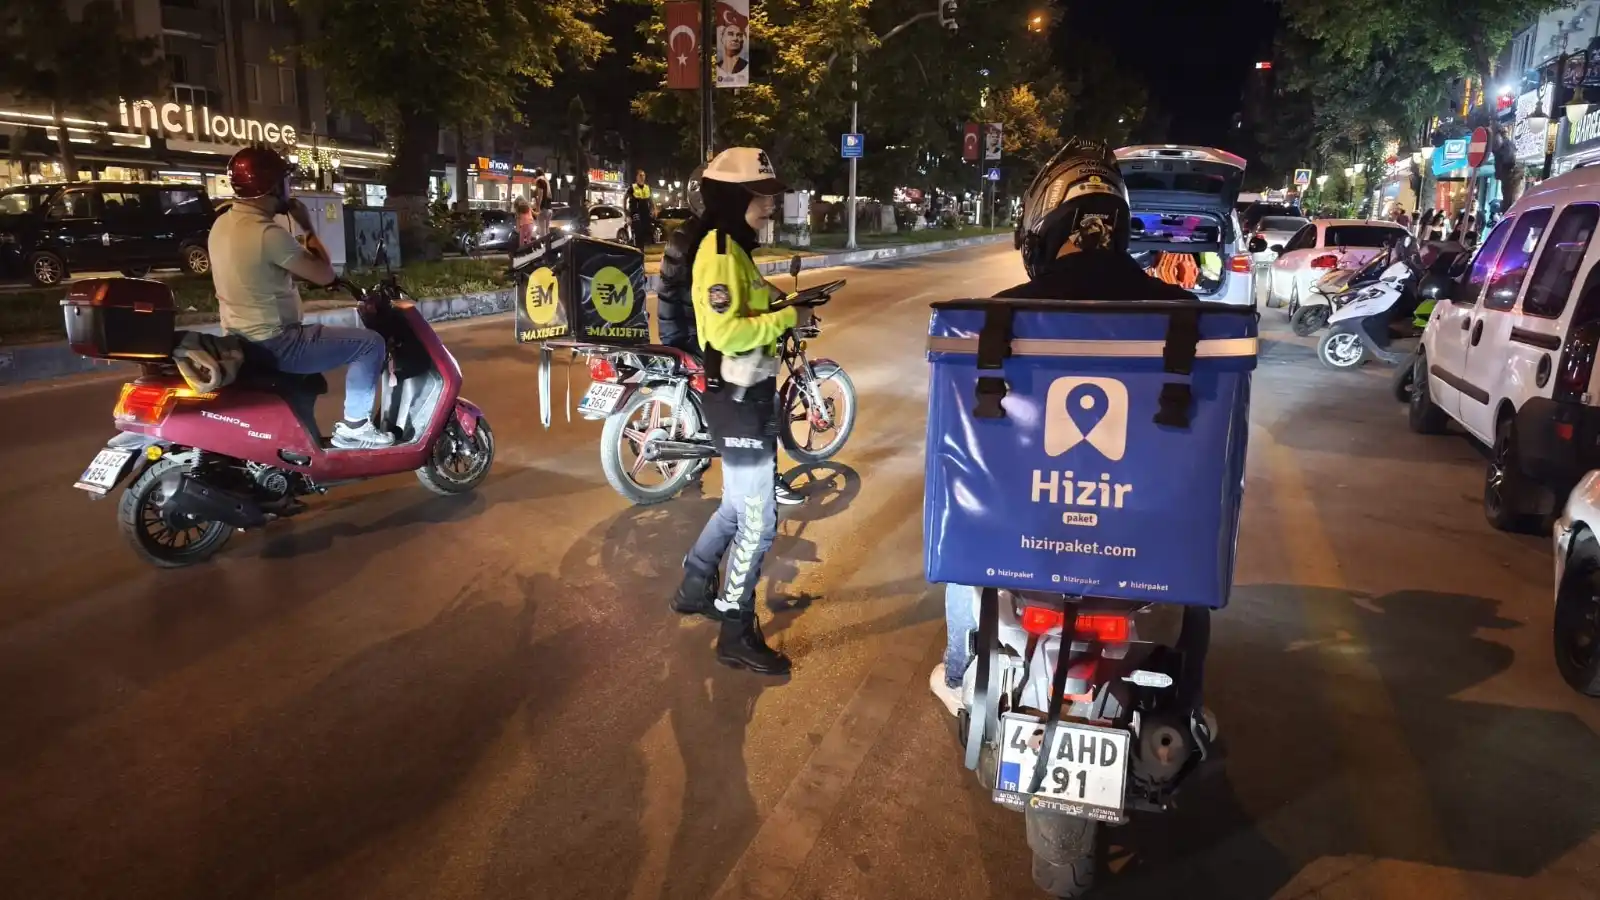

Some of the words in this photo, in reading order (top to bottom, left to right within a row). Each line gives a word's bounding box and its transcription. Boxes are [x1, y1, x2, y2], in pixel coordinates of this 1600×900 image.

[591, 385, 603, 395] 43
[602, 387, 620, 399] AHE
[589, 397, 607, 409] 360
[201, 410, 240, 424] TECHNO
[1031, 469, 1133, 509] Hizir
[1066, 514, 1094, 525] paket
[1021, 535, 1137, 558] hizirpaket.com
[998, 569, 1034, 580] hizirpaket
[1063, 575, 1100, 585] hizirpaket
[1130, 580, 1169, 591] hizirpaket
[1056, 732, 1117, 767] AHD
[1003, 779, 1017, 792] TR
[1032, 764, 1087, 798] 91
